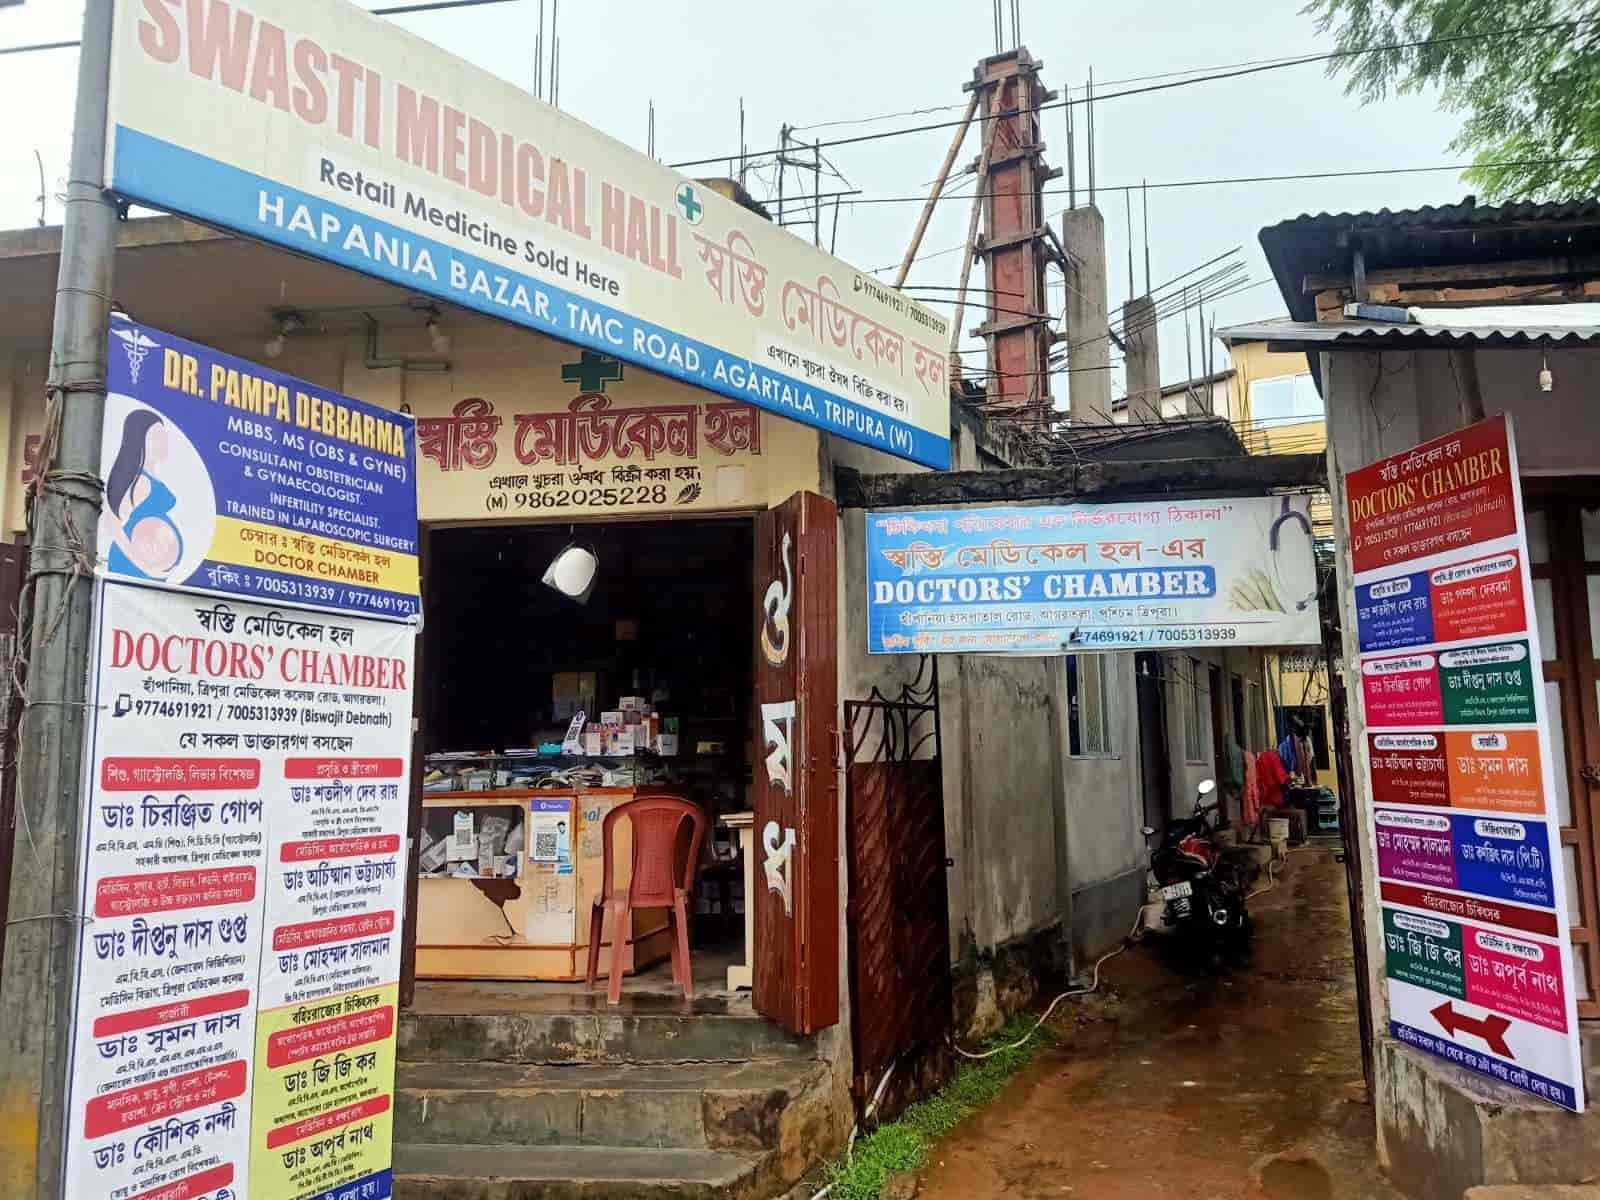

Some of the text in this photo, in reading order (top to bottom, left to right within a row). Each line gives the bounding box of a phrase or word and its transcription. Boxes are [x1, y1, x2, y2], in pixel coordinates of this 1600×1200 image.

[138, 0, 683, 280] SWASTI MEDICAL HALL
[319, 157, 620, 296] Retail Medicine Sold Here
[257, 190, 914, 455] HAPANIA BAZAR, TMC ROAD, AGARTALA, TRIPURA (W)
[692, 229, 947, 396] স্বস্তি মেডিকেল হল
[767, 343, 800, 368] এখানে
[802, 357, 825, 380] খুচরা
[875, 388, 891, 407] করা
[163, 347, 406, 459] DR. PAMPA DEBBARMA
[227, 415, 407, 482] MBBS, MS (OBS & GYNE)
[416, 392, 761, 472] স্বস্তি মেডিকেল হল
[218, 441, 384, 494] CONSULTANT OBSTETRICIAN
[1400, 447, 1444, 475] মেডিকেল
[1445, 440, 1462, 459] হল
[1421, 447, 1504, 499] CHAMBER
[244, 466, 364, 505] & GYNAECOLOGIST.
[489, 471, 529, 489] এখানে
[532, 472, 565, 488] খুচরা
[644, 468, 671, 482] করা
[270, 492, 383, 529] INFERTILITY SPECIALIST.
[485, 485, 667, 511] (M) 9862025228
[226, 500, 415, 551] TRAINED IN LAPAROSCOPIC SURGERY
[254, 549, 380, 584] DOCTOR CHAMBER
[291, 533, 316, 555] স্বস্তি
[320, 541, 371, 564] মেডিকেল
[374, 553, 391, 569] হল
[881, 537, 1207, 569] স্বস্তি মেডিকেল হল-এর
[207, 564, 241, 587] বুকিং
[255, 575, 335, 600] 7005313939
[348, 591, 416, 615] 9774691921
[1043, 569, 1211, 600] CHAMBER
[195, 604, 354, 647] স্বস্তি মেডিকেল হল
[1072, 629, 1145, 643] 74691921
[1157, 627, 1237, 641] 7005313939
[280, 647, 408, 691] CHAMBER
[1487, 671, 1502, 688] দাস
[197, 680, 230, 701] ত্রিপুরা
[233, 683, 281, 700] মেডিকেল
[135, 699, 213, 719] 9774691921
[226, 704, 297, 722] 7005313939
[300, 707, 344, 728] (Biswajit
[346, 709, 393, 729] Debnath)
[179, 732, 353, 753] যে সকল ডাক্তারগণ বসছেন
[1478, 756, 1503, 780] সুমন
[1506, 757, 1529, 776] দাস
[313, 779, 353, 803] শতদীপ
[357, 783, 377, 802] দেব
[379, 783, 399, 801] রায়
[101, 794, 264, 831] ডাঃ চিরঞ্জিত গোপ
[93, 928, 125, 960] ডাঃ
[183, 919, 213, 949] দাস
[218, 912, 249, 944] গুপ্ত
[350, 937, 391, 960] সালমান
[1407, 932, 1423, 957] জি
[1424, 936, 1440, 962] জি
[1442, 945, 1462, 969] কর
[1468, 954, 1559, 995] ডাঃ অপূর্ব নাথ
[96, 1034, 138, 1059] ডাঃ
[145, 1022, 198, 1053] সুমন
[204, 1012, 241, 1035] দাস
[283, 1070, 308, 1092] ডাঃ
[312, 1058, 331, 1087] জি
[334, 1053, 352, 1081] জি
[355, 1050, 377, 1071] কর
[1510, 1067, 1529, 1088] রোগী
[93, 1141, 126, 1170] ডাঃ
[134, 1116, 201, 1160] কৌশিক
[204, 1101, 238, 1135] নন্দী
[310, 1126, 347, 1158] অপূর্ব
[349, 1121, 374, 1144] নাথ
